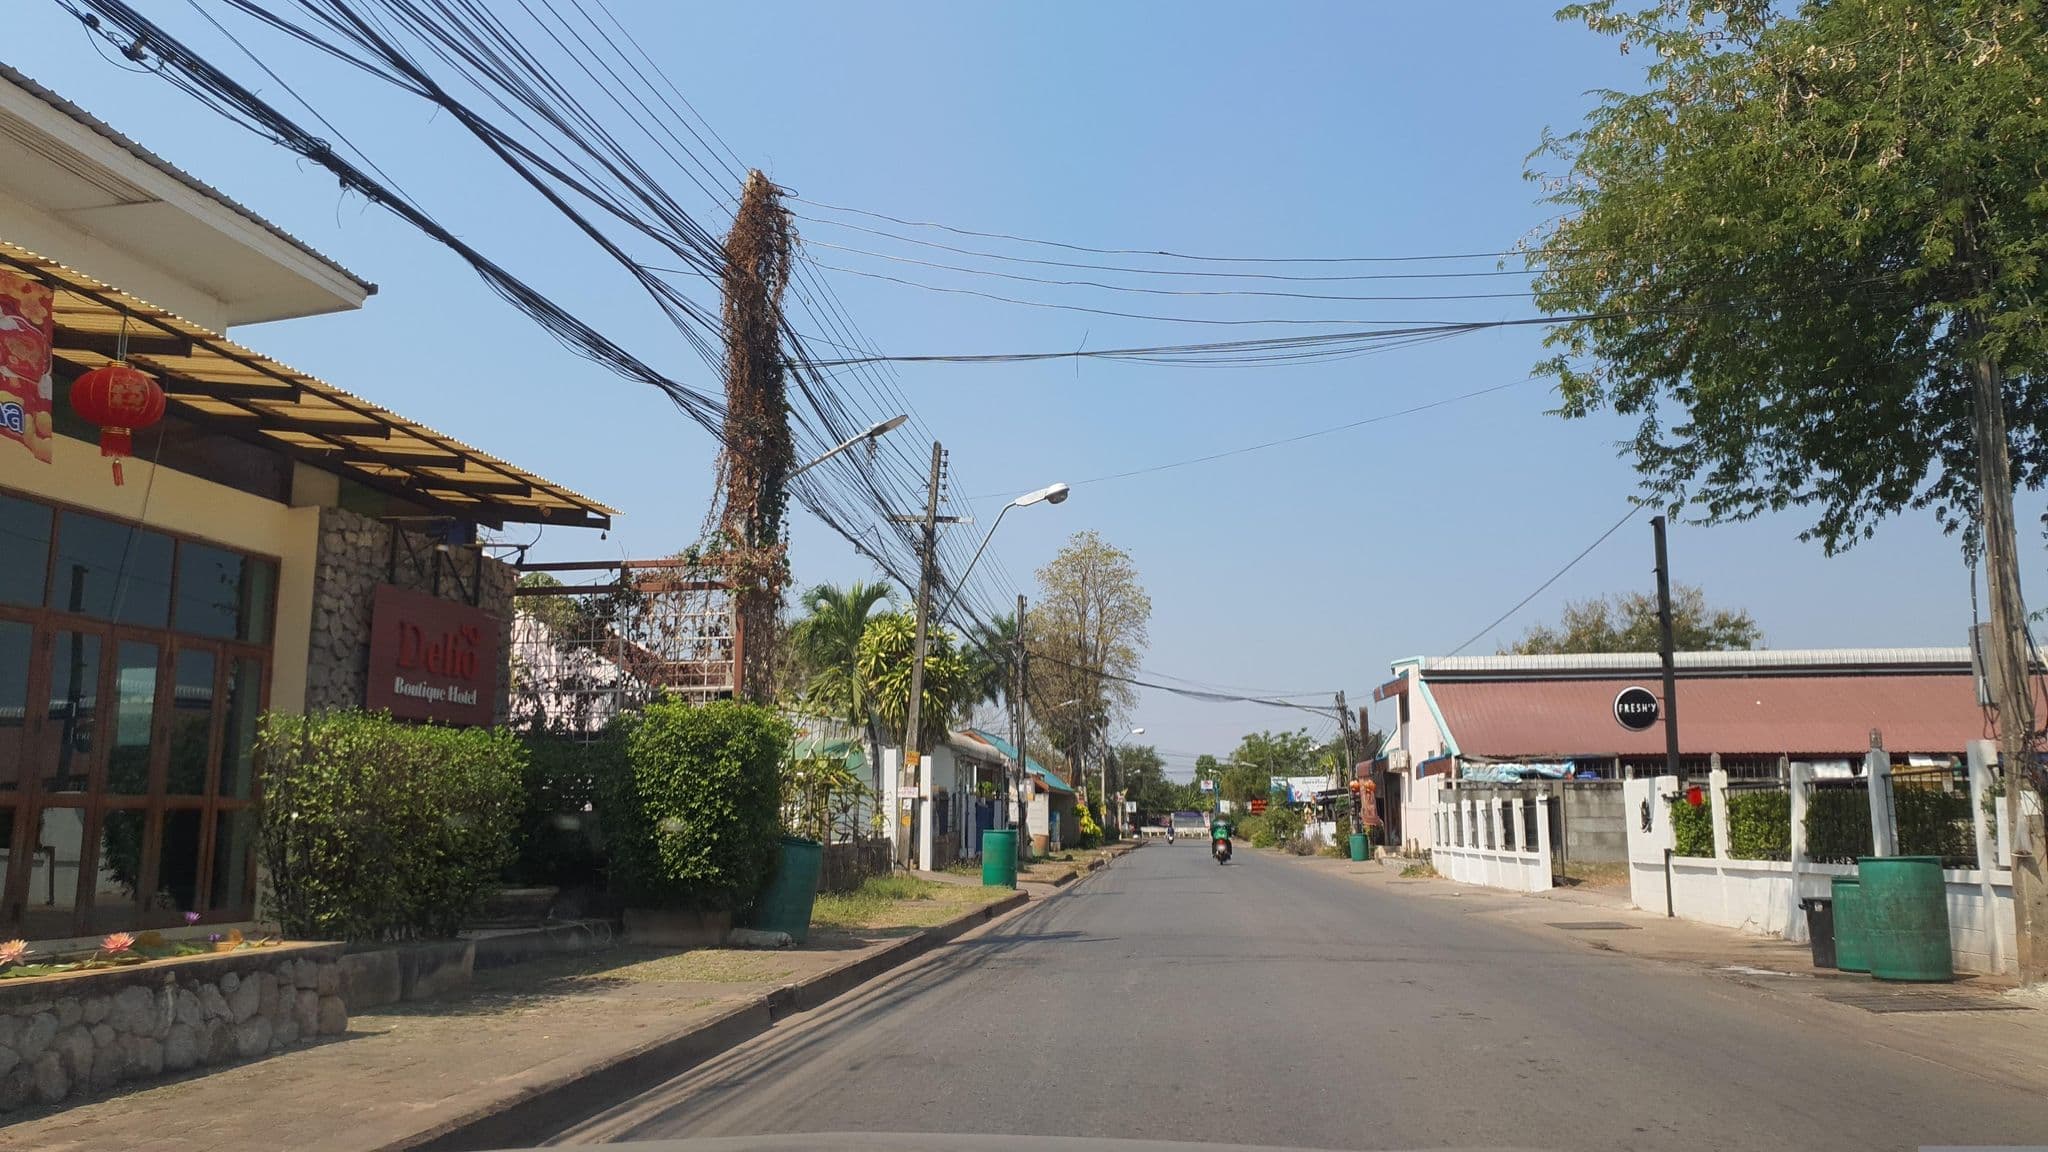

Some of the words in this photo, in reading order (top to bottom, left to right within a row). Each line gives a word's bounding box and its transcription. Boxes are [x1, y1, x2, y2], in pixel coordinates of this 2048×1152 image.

[394, 676, 446, 703] Boutique
[447, 685, 478, 705] Hotel
[1618, 703, 1657, 713] FRESH'Y
